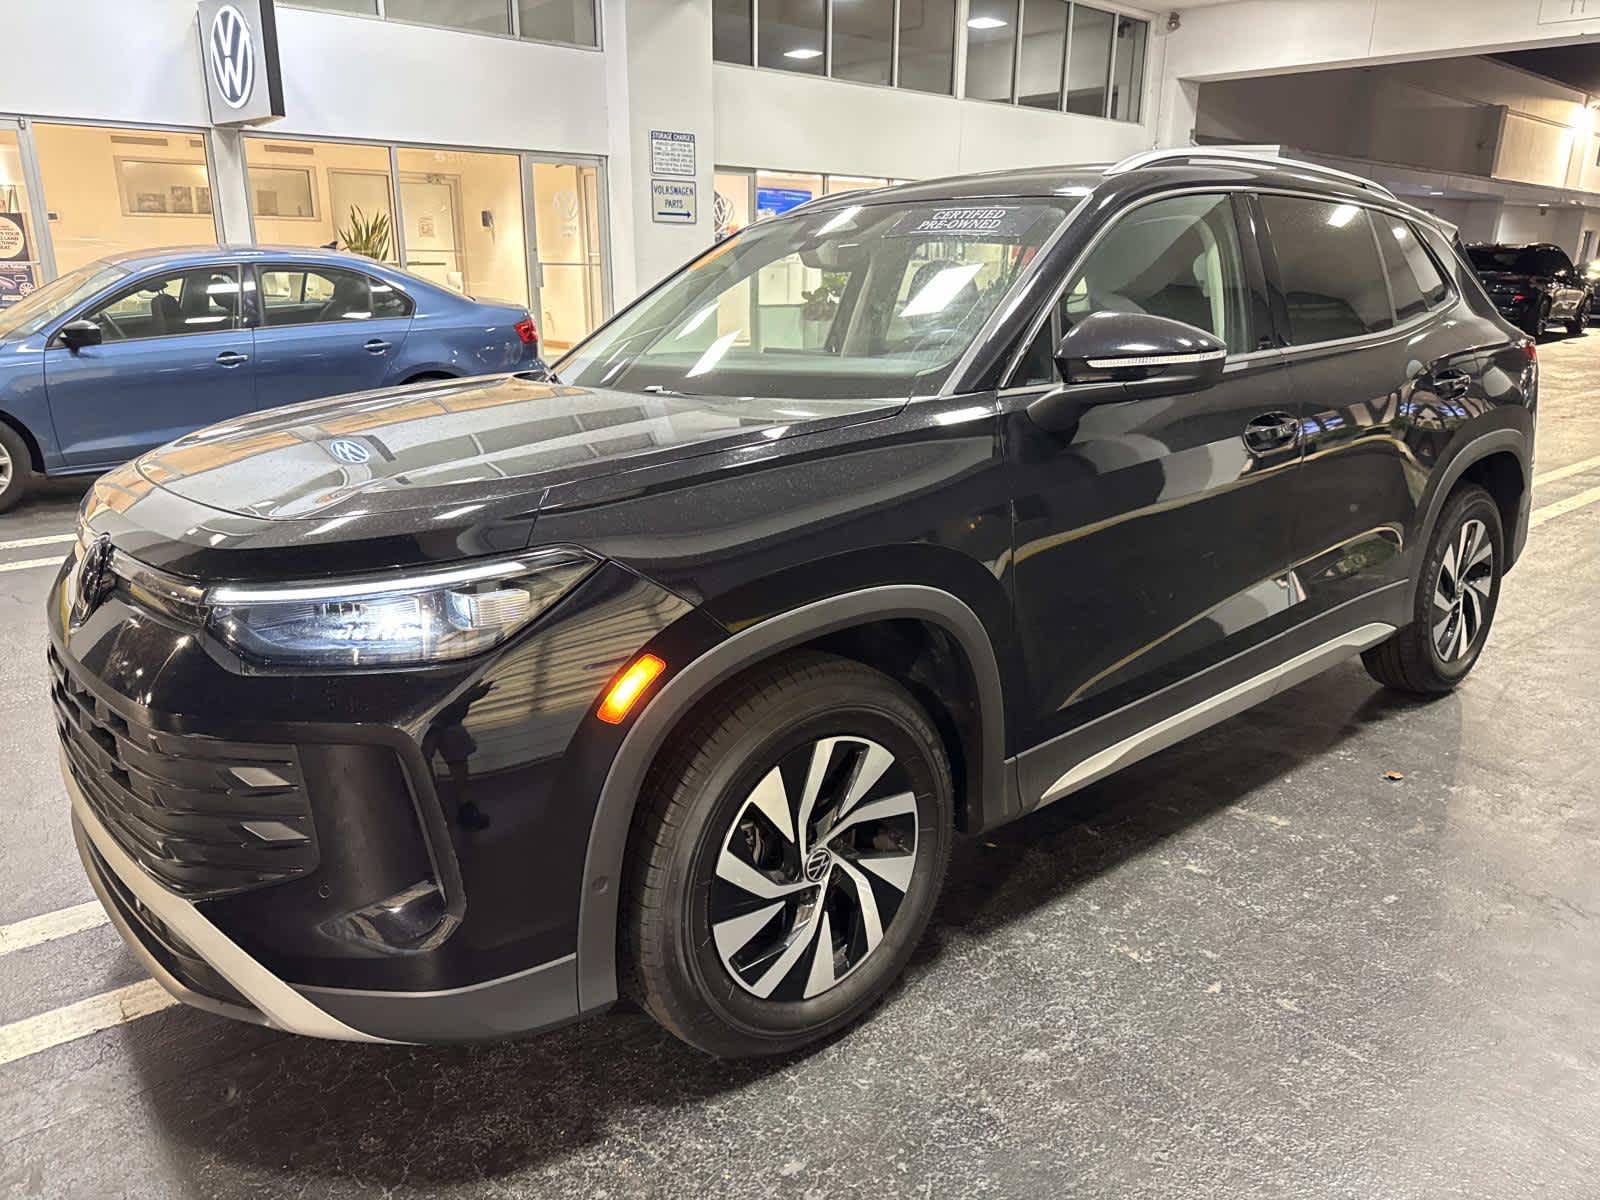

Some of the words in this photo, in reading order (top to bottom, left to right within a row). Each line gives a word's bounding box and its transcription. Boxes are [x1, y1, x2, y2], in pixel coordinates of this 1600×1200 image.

[212, 7, 251, 106] VW
[653, 184, 694, 196] VOLKSWAGEN
[664, 199, 683, 209] PARTS
[932, 210, 1006, 220] CERTIFIED
[917, 220, 1002, 230] PRE-OWNED
[807, 850, 830, 881] VW
